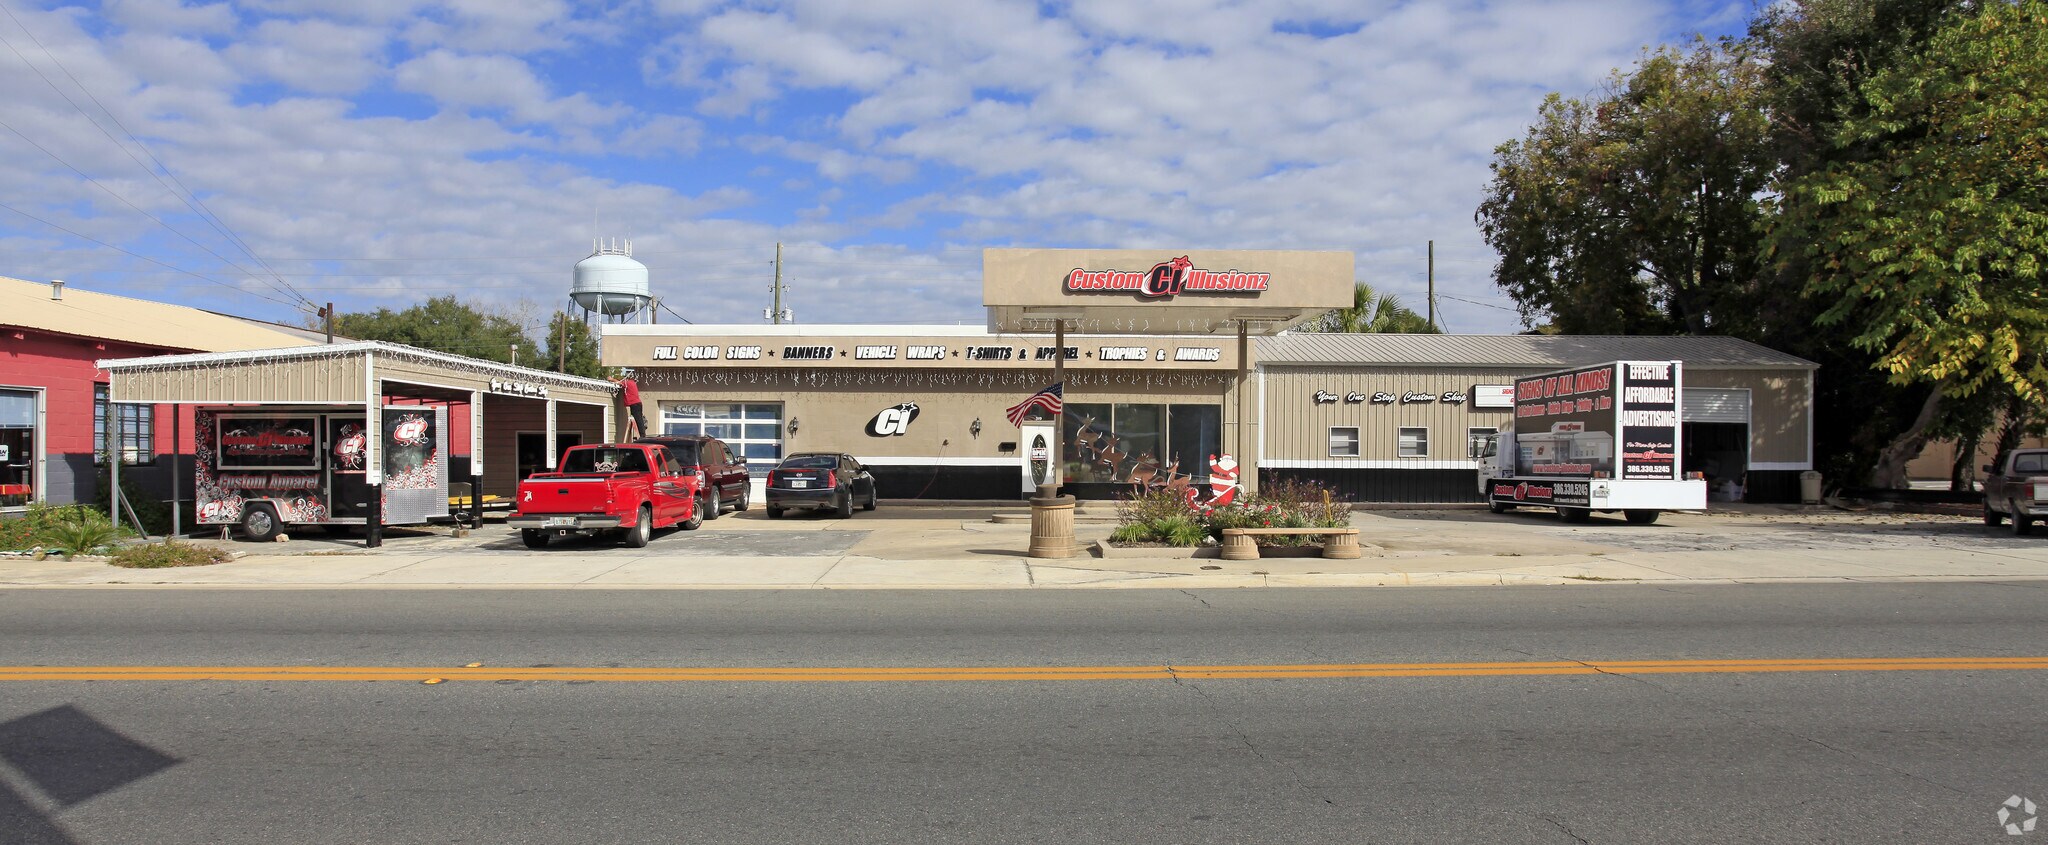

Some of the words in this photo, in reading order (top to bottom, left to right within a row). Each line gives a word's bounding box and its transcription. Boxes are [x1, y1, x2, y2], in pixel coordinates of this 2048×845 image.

[1069, 268, 1144, 290] Custom
[1185, 268, 1271, 291] Illusionz
[653, 346, 678, 360] FULL
[683, 346, 719, 360] COLOR
[725, 346, 762, 360] SIGNS
[782, 346, 835, 360] BANNERS
[855, 346, 897, 360] VEHICLE
[906, 346, 946, 360] WRAPS
[965, 346, 1013, 360] T-SHIRTS
[1018, 349, 1027, 360] &
[1034, 347, 1079, 361] APPREL
[1099, 347, 1148, 361] TROPHIES
[1155, 349, 1166, 361] &
[1173, 347, 1220, 361] AWARDS
[1629, 365, 1669, 380] EFFECTIVE
[1517, 379, 1543, 401] SIGNS
[1544, 377, 1558, 398] OF
[1556, 374, 1574, 396] ALL
[1574, 368, 1612, 394] KINDS!
[1315, 390, 1340, 404] Your
[1346, 391, 1366, 402] One
[1373, 391, 1396, 404] Stop
[1402, 391, 1437, 403] Custom
[1441, 391, 1468, 405] Shop
[1624, 386, 1675, 403] AFFORDABLE
[1623, 410, 1675, 427] ADVERTISING
[1626, 465, 1670, 473] 386.330.5245
[218, 475, 267, 491] Custom
[269, 473, 321, 491] Apparel
[1494, 484, 1514, 496] Custom
[1528, 485, 1552, 499] Illusionz
[1553, 483, 1588, 497] 386.330.5245
